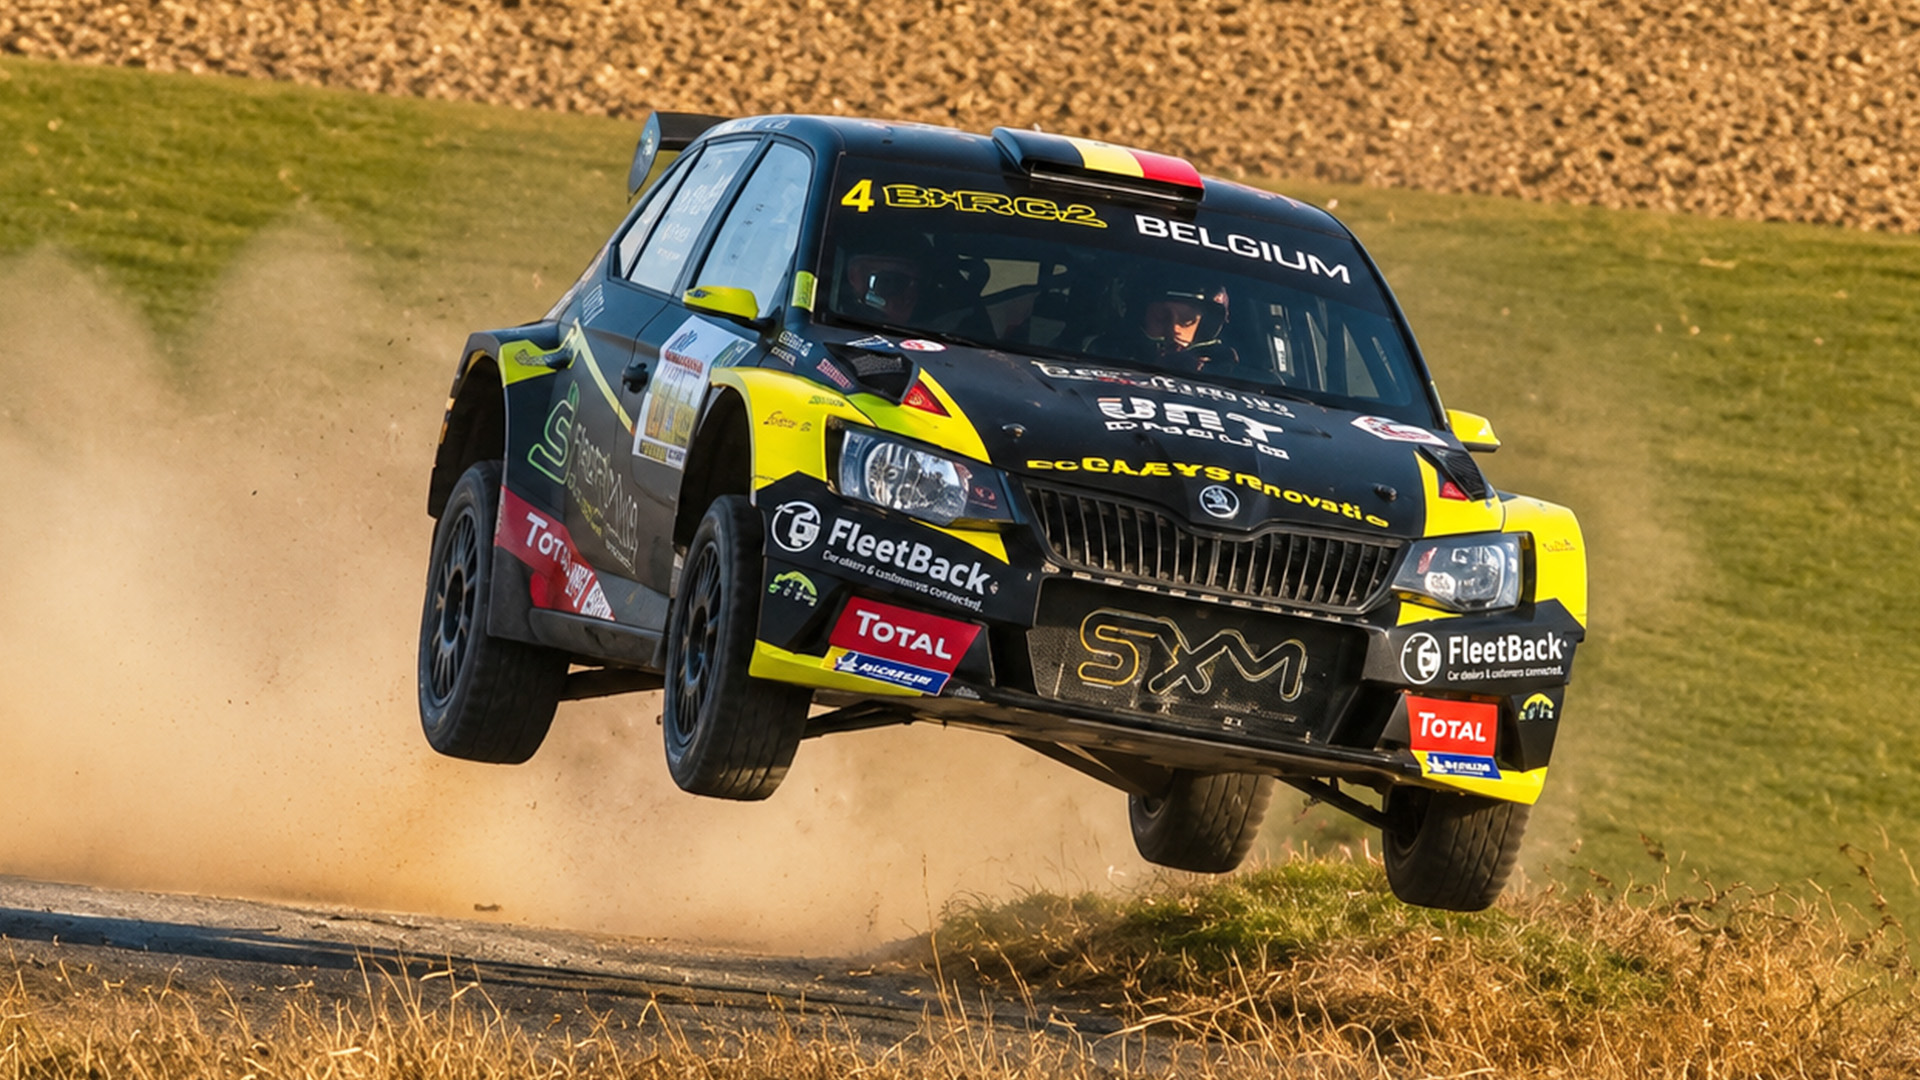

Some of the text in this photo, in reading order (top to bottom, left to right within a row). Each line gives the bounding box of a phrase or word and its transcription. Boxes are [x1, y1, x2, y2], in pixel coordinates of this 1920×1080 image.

[841, 179, 875, 213] 4
[1135, 214, 1351, 285] BELGIUM
[526, 512, 572, 577] TOT
[827, 518, 991, 595] FleetBack
[856, 609, 952, 660] TOTAL
[1077, 607, 1308, 702] SXM
[1449, 632, 1563, 665] FleetBack
[1418, 711, 1487, 743] TOTAL
